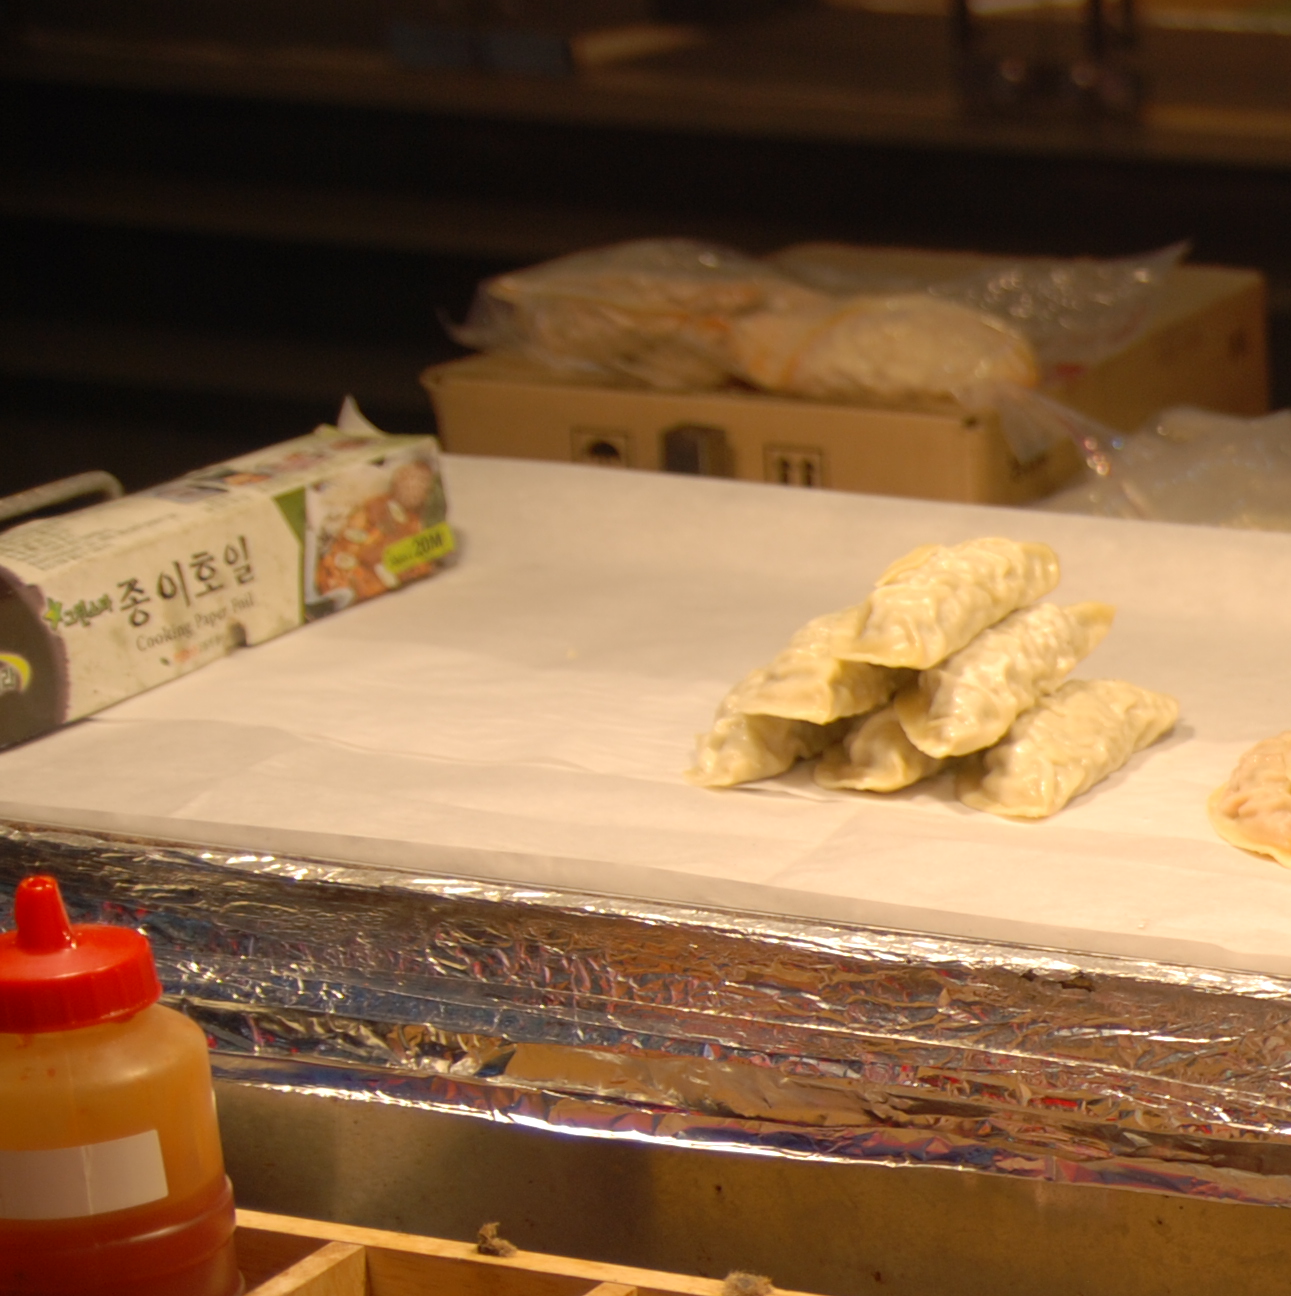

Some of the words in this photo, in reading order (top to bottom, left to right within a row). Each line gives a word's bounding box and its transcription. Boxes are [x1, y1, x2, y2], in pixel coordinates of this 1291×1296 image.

[116, 535, 254, 627] 종이호일
[136, 623, 192, 652] Cooking
[194, 607, 227, 629] Paper
